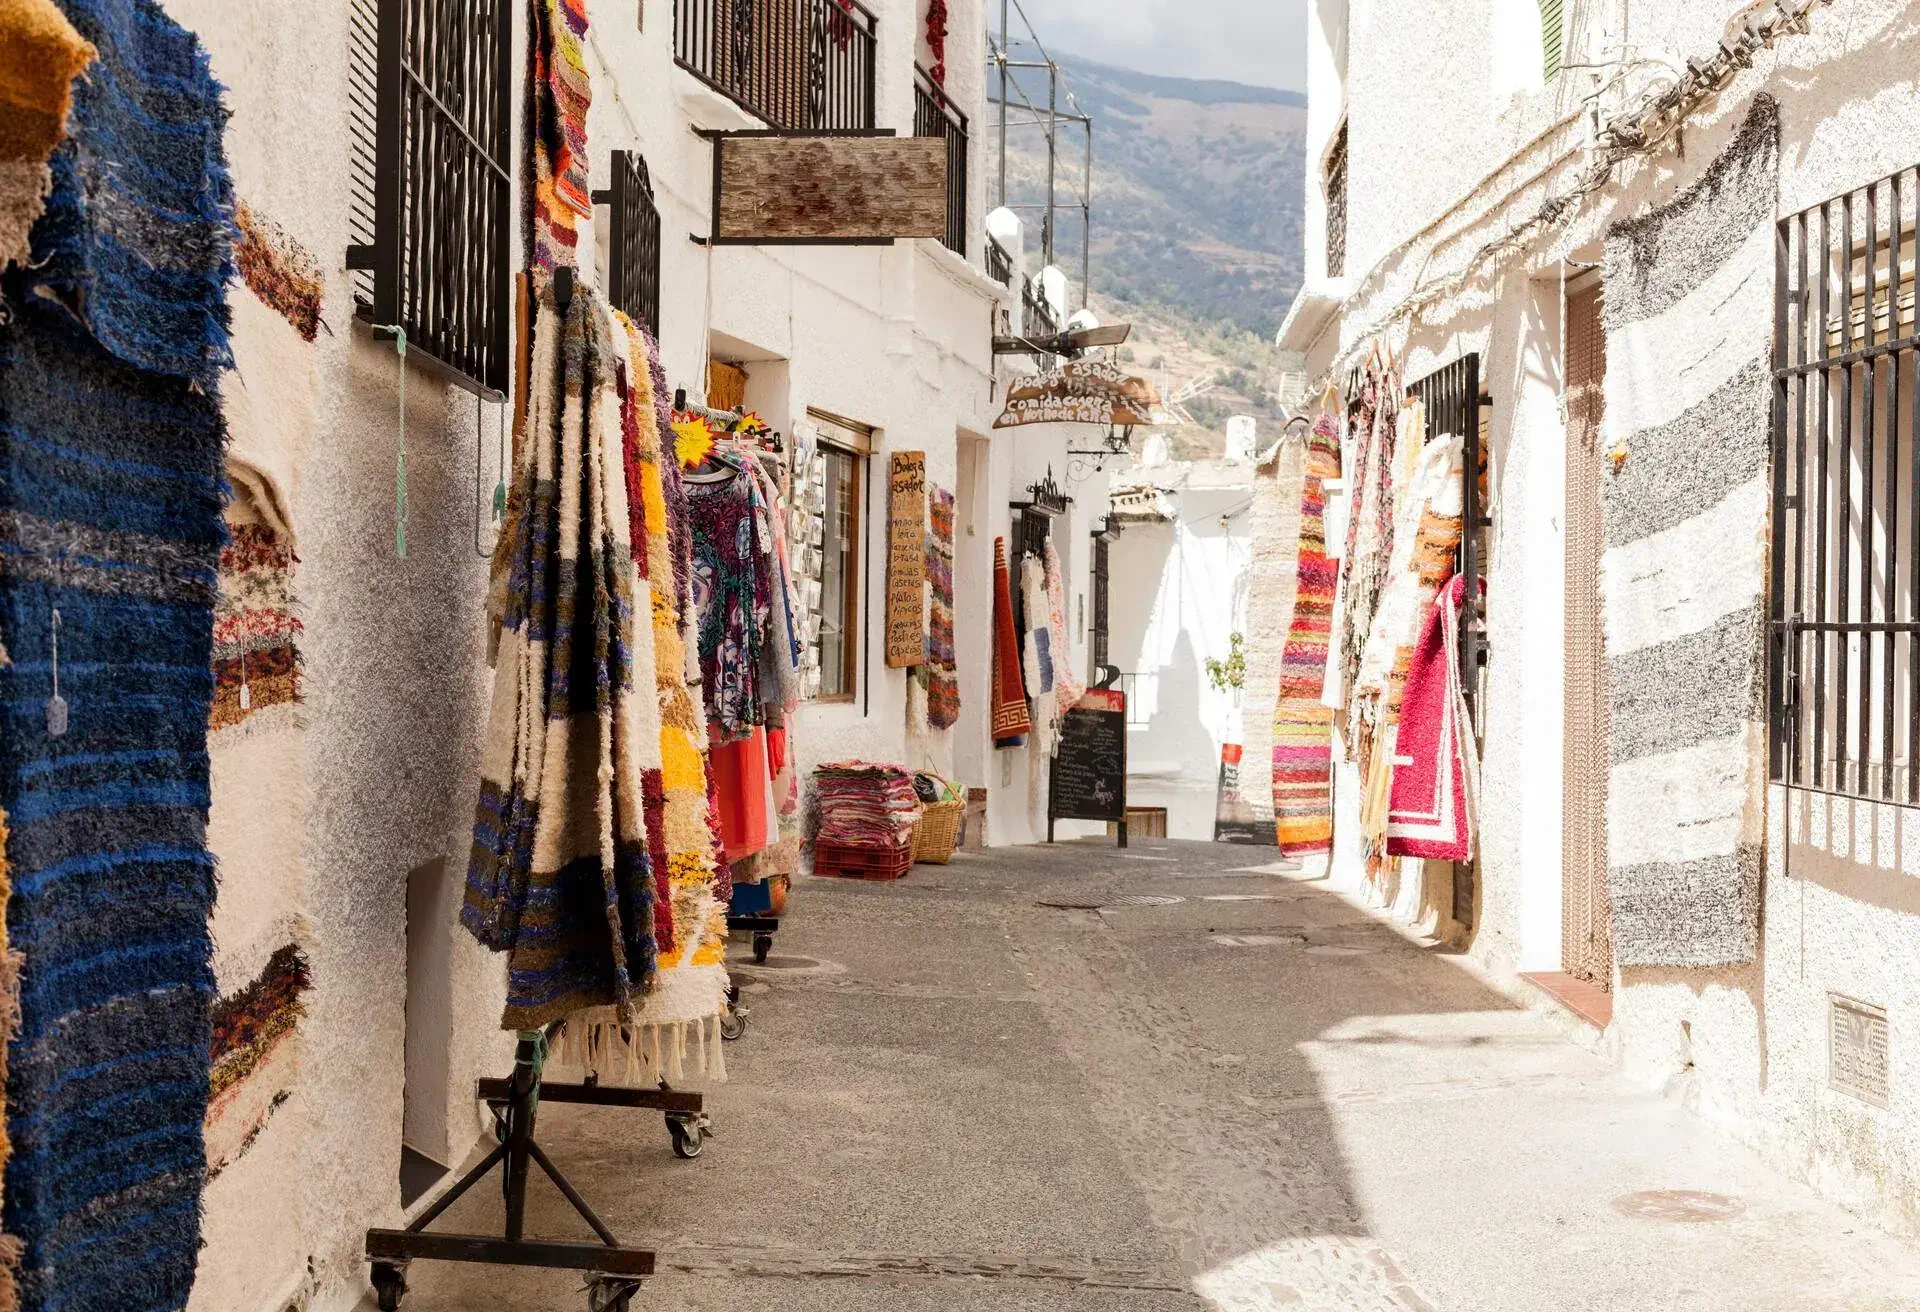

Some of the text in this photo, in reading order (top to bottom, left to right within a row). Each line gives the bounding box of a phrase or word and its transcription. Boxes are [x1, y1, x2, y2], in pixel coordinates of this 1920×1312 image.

[1011, 361, 1129, 393] Bodega asador
[1007, 391, 1062, 411] comida
[1000, 412, 1019, 424] en
[892, 454, 925, 479] Bodega
[892, 480, 924, 493] asador
